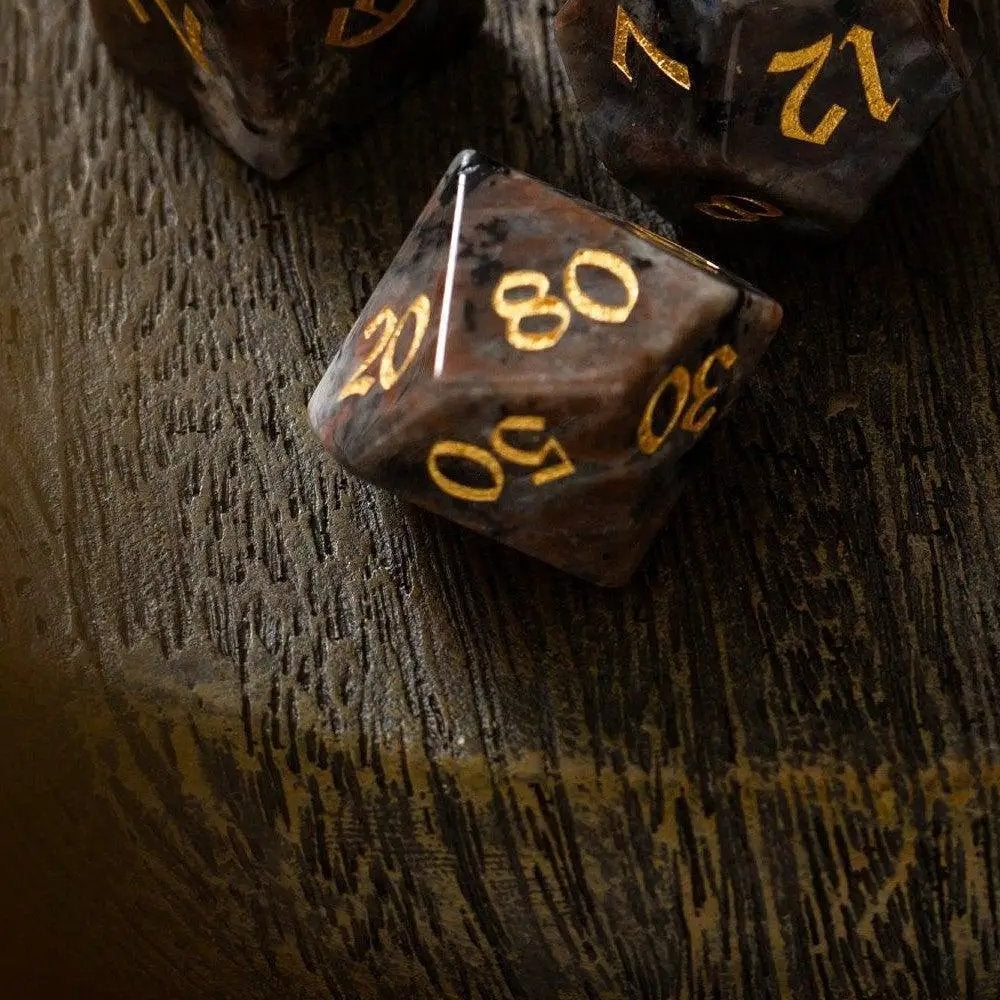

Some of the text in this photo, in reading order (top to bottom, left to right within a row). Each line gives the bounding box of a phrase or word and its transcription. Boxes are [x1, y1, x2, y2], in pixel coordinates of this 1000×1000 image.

[765, 23, 900, 146] 12
[338, 294, 431, 401] 20
[492, 247, 640, 352] 80
[636, 343, 739, 457] 30
[425, 413, 576, 503] 50
